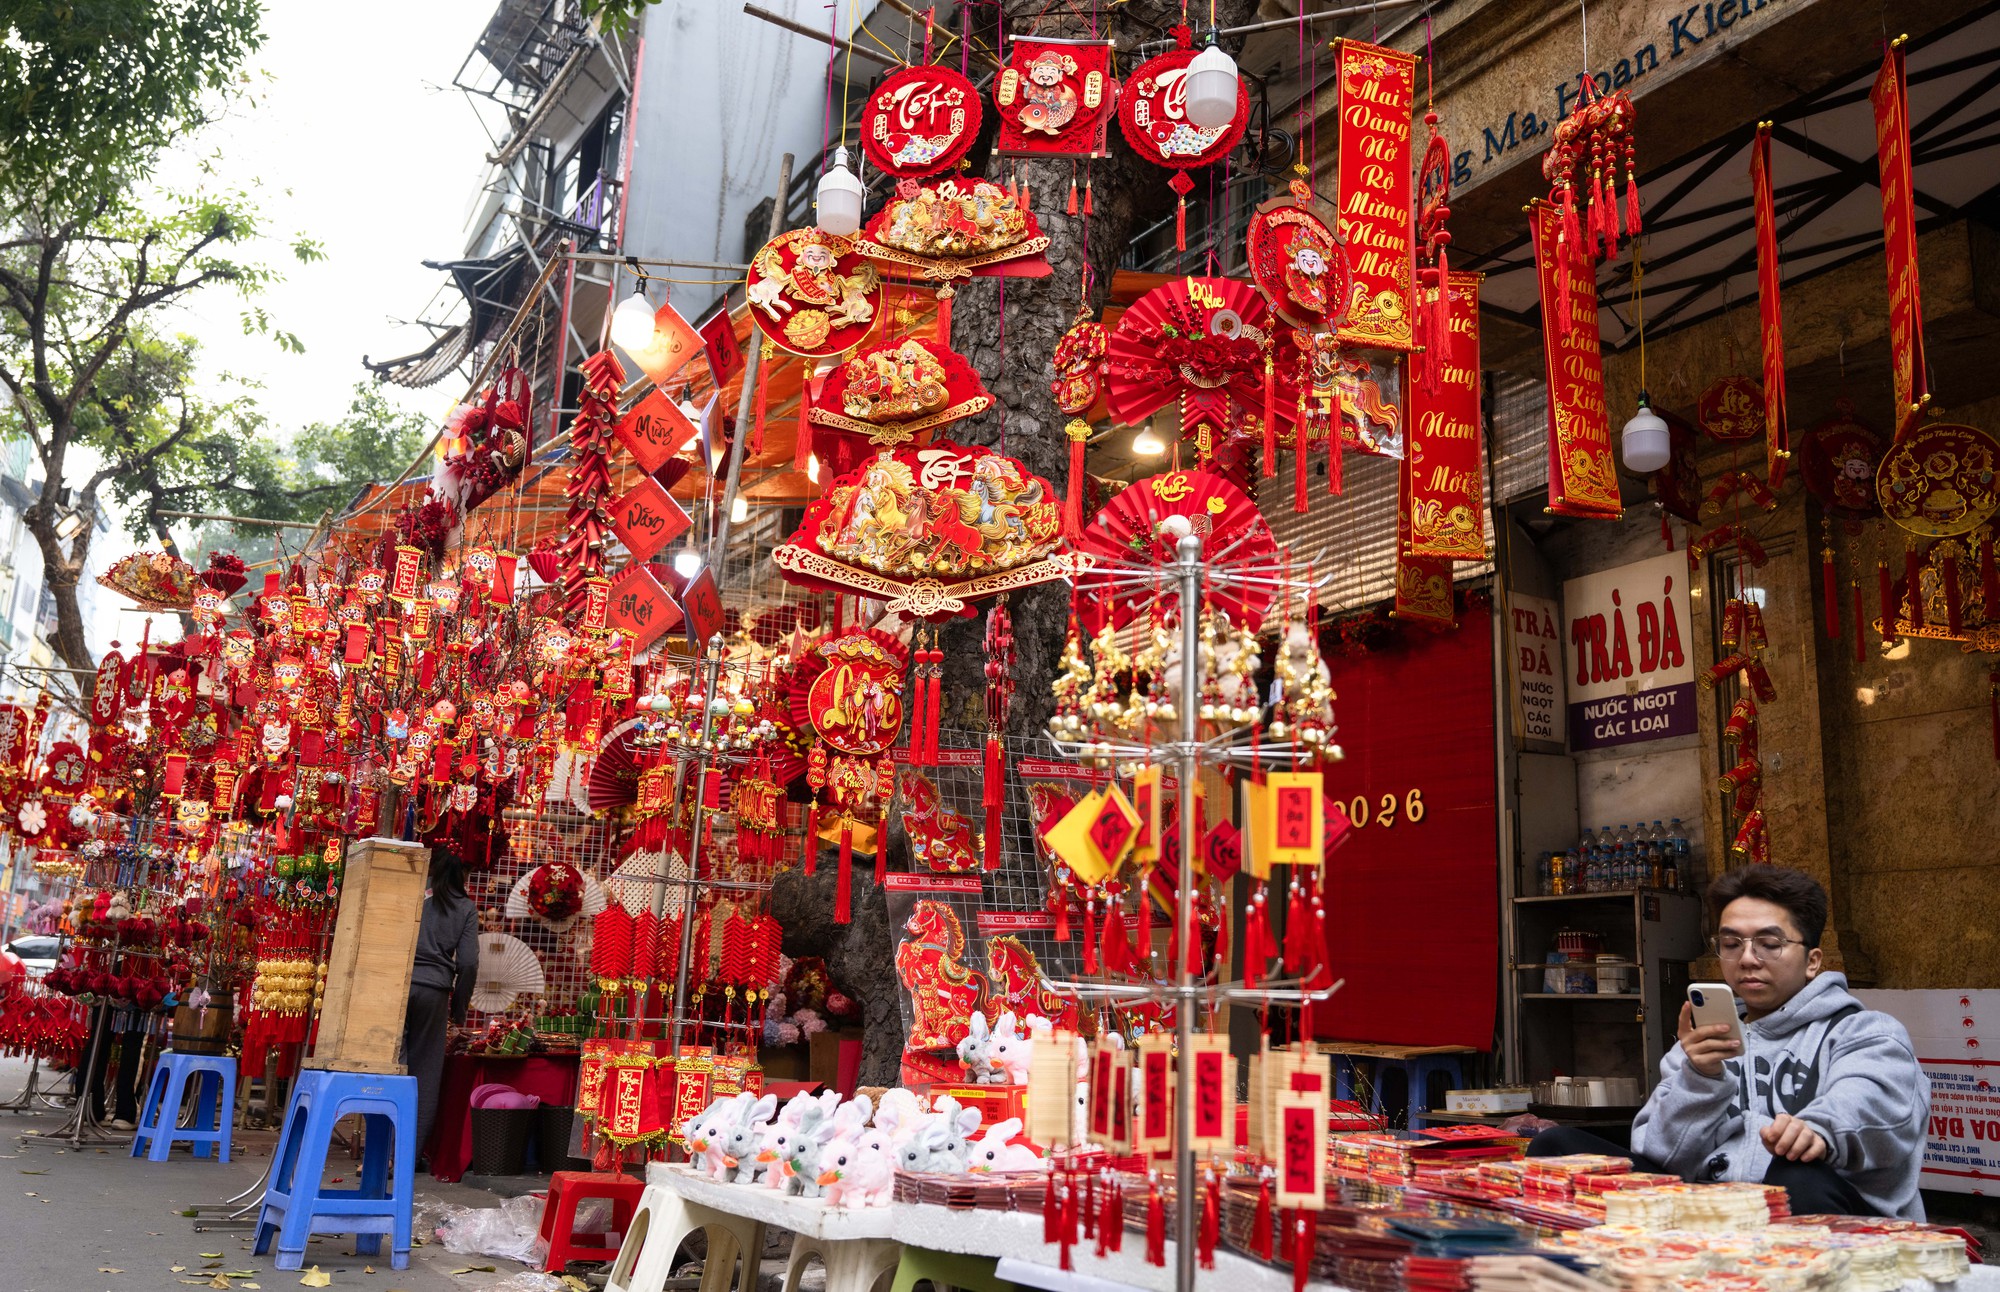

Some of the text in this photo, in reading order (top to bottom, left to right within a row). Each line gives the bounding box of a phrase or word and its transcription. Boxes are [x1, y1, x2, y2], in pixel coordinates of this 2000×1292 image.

[1354, 79, 1400, 107] Mai
[1345, 104, 1409, 142] Vàng
[1359, 135, 1397, 162] Nở
[1482, 112, 1547, 164] Ma,
[1360, 164, 1394, 195] Rộ
[1340, 191, 1408, 228] Mừng
[1346, 220, 1405, 252] Năm
[1352, 250, 1400, 278] Mới
[1420, 411, 1476, 439] Năm
[1512, 607, 1557, 640] TRÀ
[1571, 575, 1685, 687] TRÀ ĐÁ
[1520, 643, 1553, 676] ĐÁ
[1522, 680, 1554, 695] NƯỚC
[1522, 694, 1554, 709] NGỌT
[1527, 709, 1551, 723] CÁC
[1584, 690, 1678, 721] NƯỚC NGỌT
[1527, 723, 1552, 738] LOẠI
[1594, 713, 1670, 740] CÁC LOẠI
[1959, 1073, 1975, 1082] MST:
[1930, 1104, 1940, 1113] BÁ
[1970, 1119, 2000, 1142] OA
